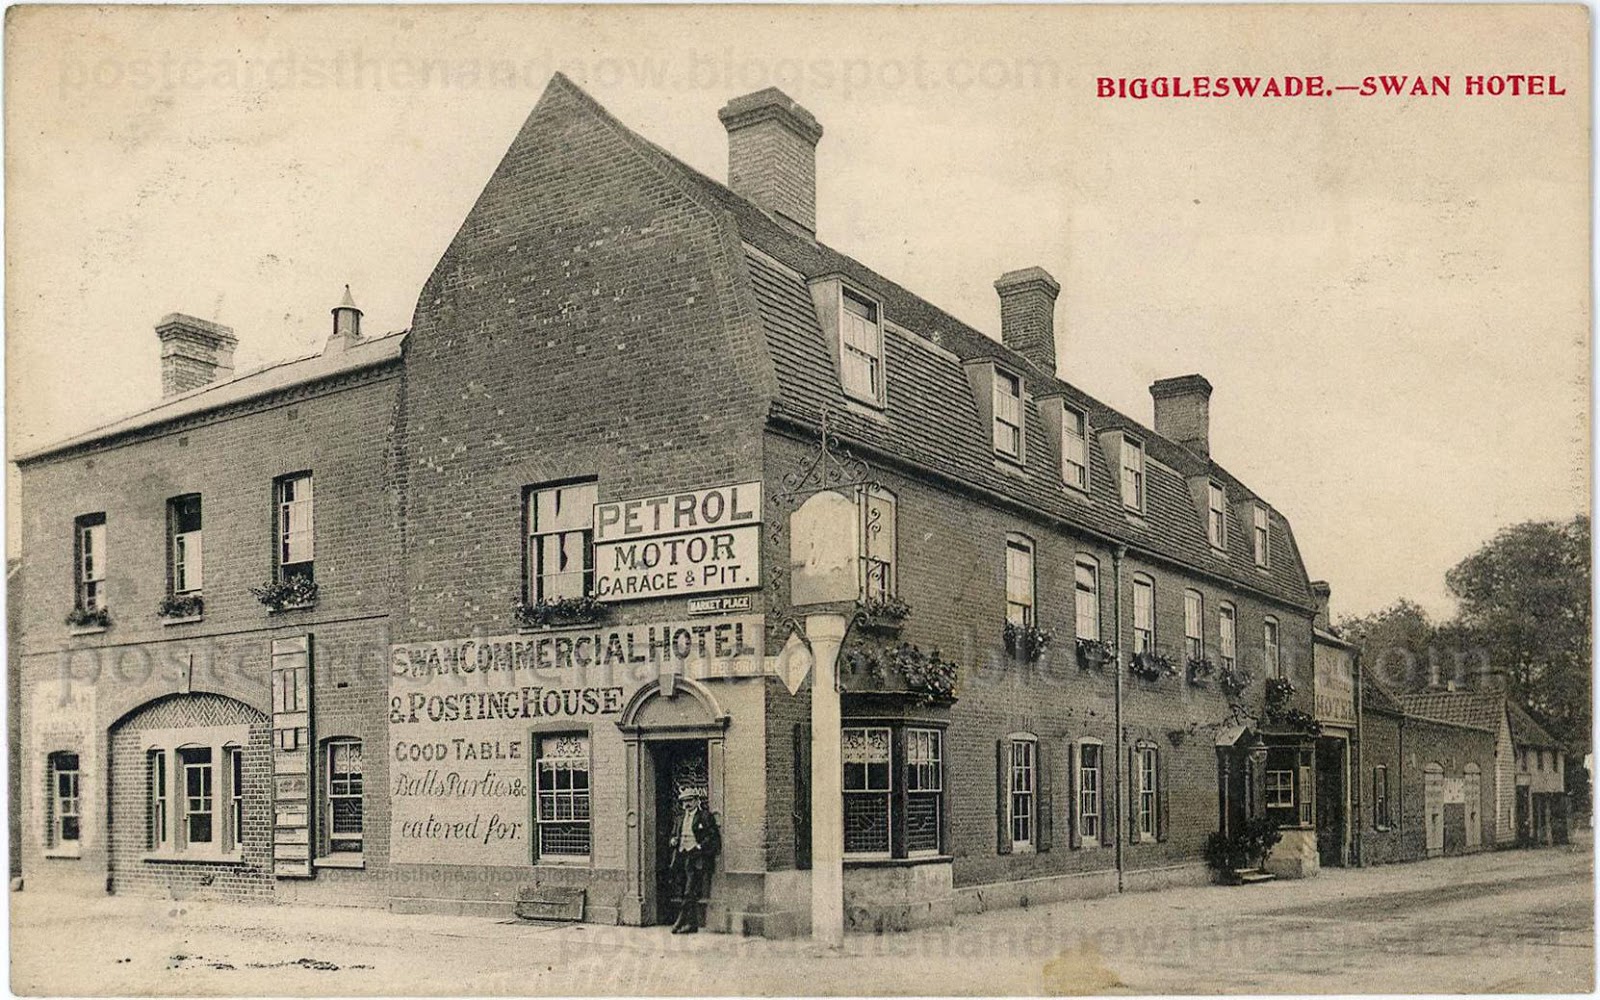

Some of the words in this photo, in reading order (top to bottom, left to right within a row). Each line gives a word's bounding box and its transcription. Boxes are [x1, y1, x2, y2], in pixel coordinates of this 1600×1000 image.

[599, 487, 753, 538] PETROL
[613, 533, 736, 572] MOTOR
[597, 571, 678, 597] GARAGE
[684, 570, 695, 587] &
[703, 565, 750, 586] PIT.
[690, 599, 722, 612] MARKET
[723, 597, 750, 610] PLACE
[391, 645, 460, 678] SWAN
[459, 631, 646, 674] COMMERCIAL
[649, 622, 755, 662] HOTEL
[407, 691, 519, 724] POSTING
[520, 686, 624, 719] HOUSE
[395, 741, 448, 762] GOOD
[451, 738, 522, 761] TABLE
[401, 813, 481, 839] catered
